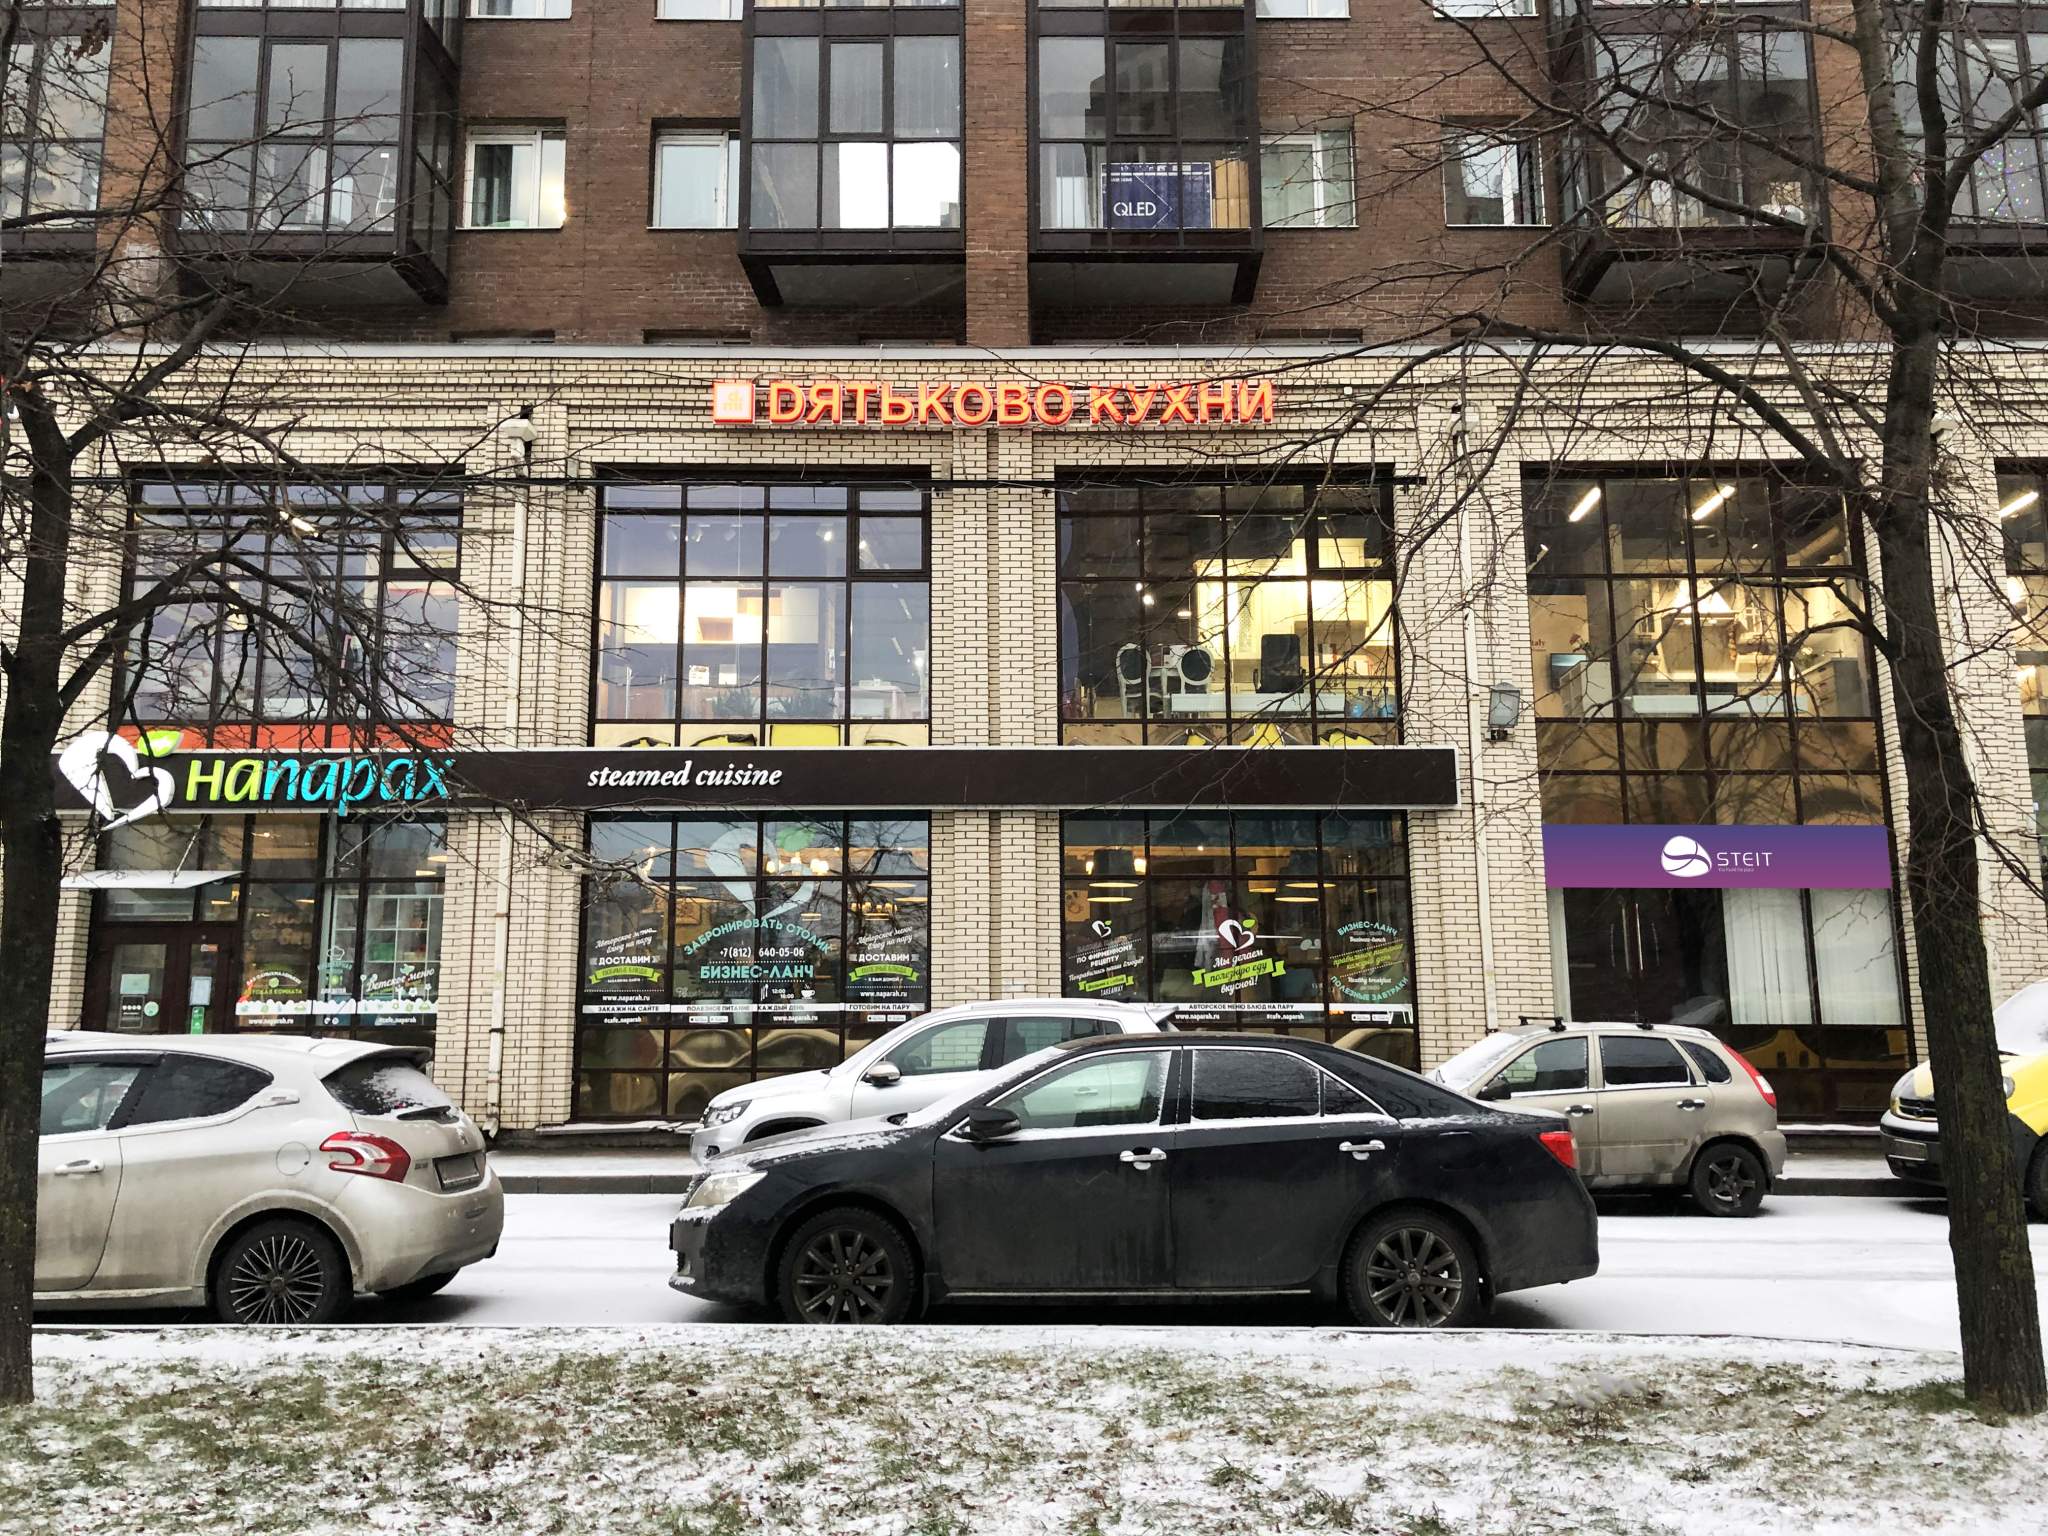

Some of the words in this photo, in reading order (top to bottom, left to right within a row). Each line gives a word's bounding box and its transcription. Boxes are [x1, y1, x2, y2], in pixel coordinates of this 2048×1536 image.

[1113, 201, 1156, 217] QLED
[1090, 382, 1276, 425] КУХНИ
[587, 760, 693, 787] steamed
[695, 763, 782, 786] cuisine
[1716, 852, 1773, 867] STEIT
[684, 918, 783, 956] ЗАБРОНИРОВАТЬ
[786, 923, 833, 954] СТОЛИК
[1337, 921, 1398, 937] БИЗНЕС-ЛАНЧ
[720, 946, 751, 958] +7(812)
[758, 947, 805, 957] 640-05-06
[858, 953, 910, 962] ДОСТАВИМ
[1213, 957, 1230, 968] Мы
[1231, 949, 1264, 967] делаем
[598, 956, 651, 965] ДОСТАВИМ
[1251, 961, 1268, 973] еду
[700, 964, 814, 979] БИЗНЕС-ЛАНЧ
[1220, 975, 1259, 996] вкусной!
